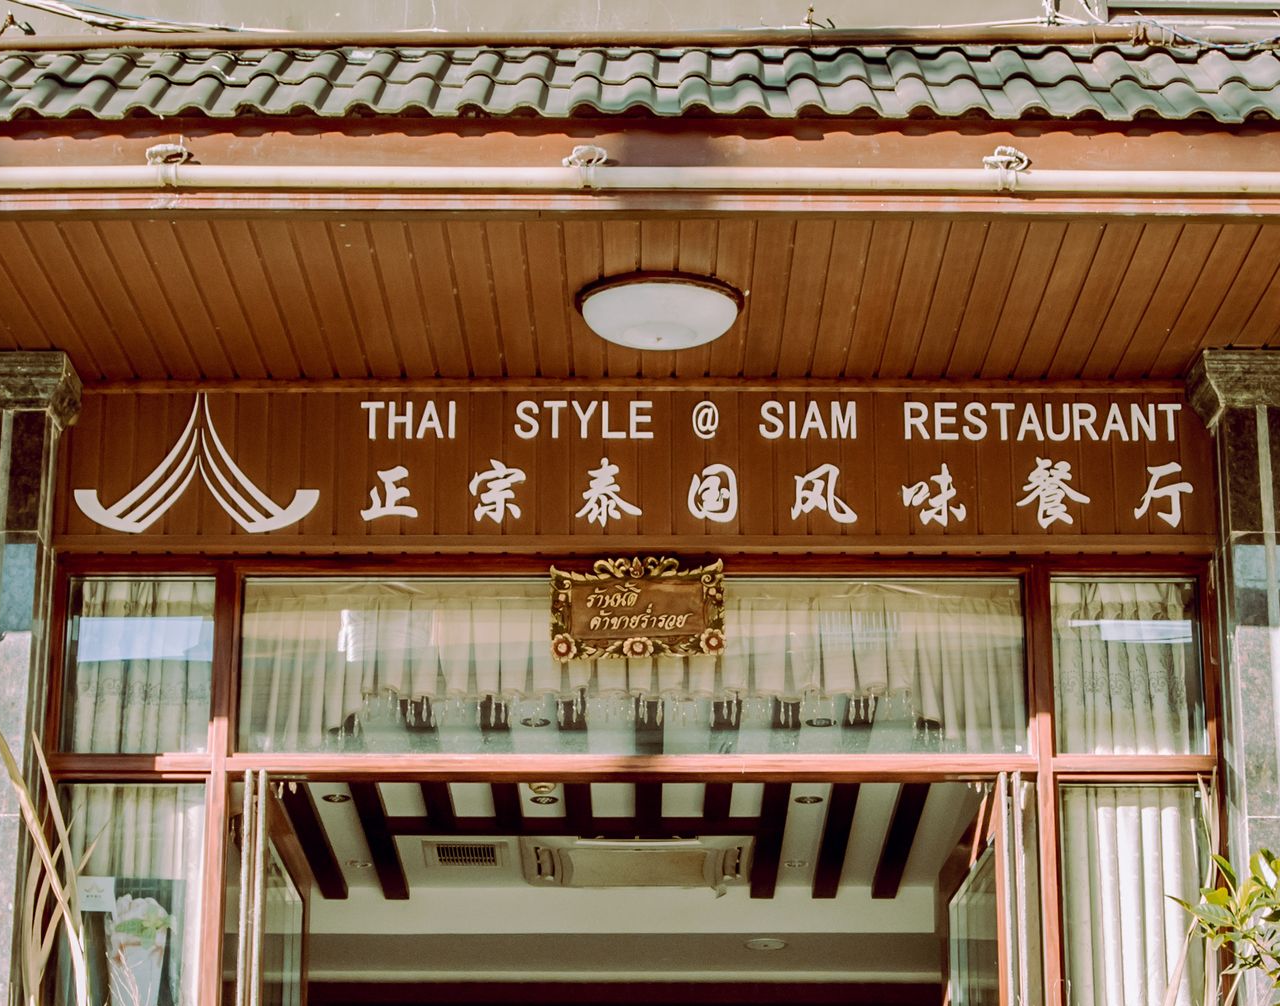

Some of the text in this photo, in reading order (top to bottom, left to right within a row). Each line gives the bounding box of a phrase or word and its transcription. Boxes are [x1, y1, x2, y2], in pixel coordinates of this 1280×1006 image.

[360, 400, 1182, 442] THAI STYLE @ SIAM RESTAURANT
[360, 456, 1194, 529] 正宗泰国风味餐厅
